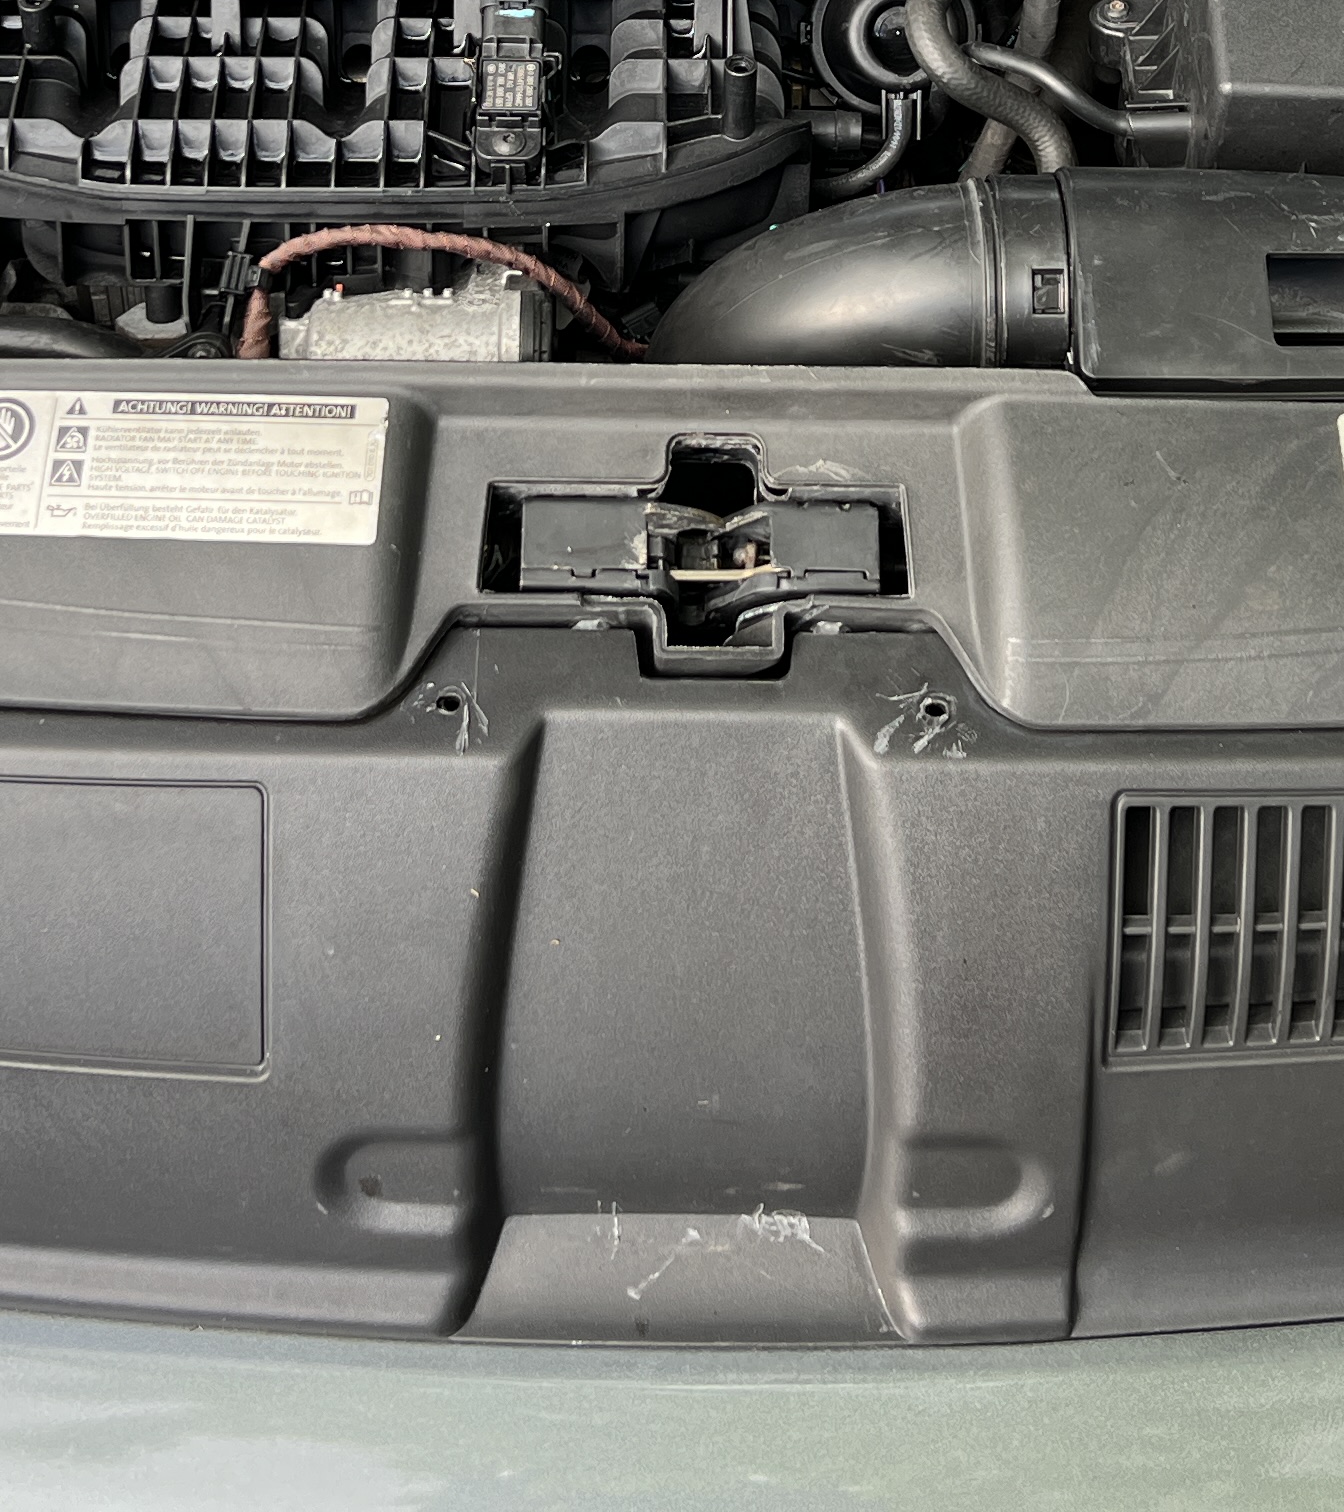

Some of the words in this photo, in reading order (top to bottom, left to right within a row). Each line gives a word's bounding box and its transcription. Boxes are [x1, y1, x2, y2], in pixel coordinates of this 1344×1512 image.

[116, 399, 192, 414] ACHTUNG!
[193, 401, 268, 415] WARNING!
[269, 402, 351, 418] ATTENTION!
